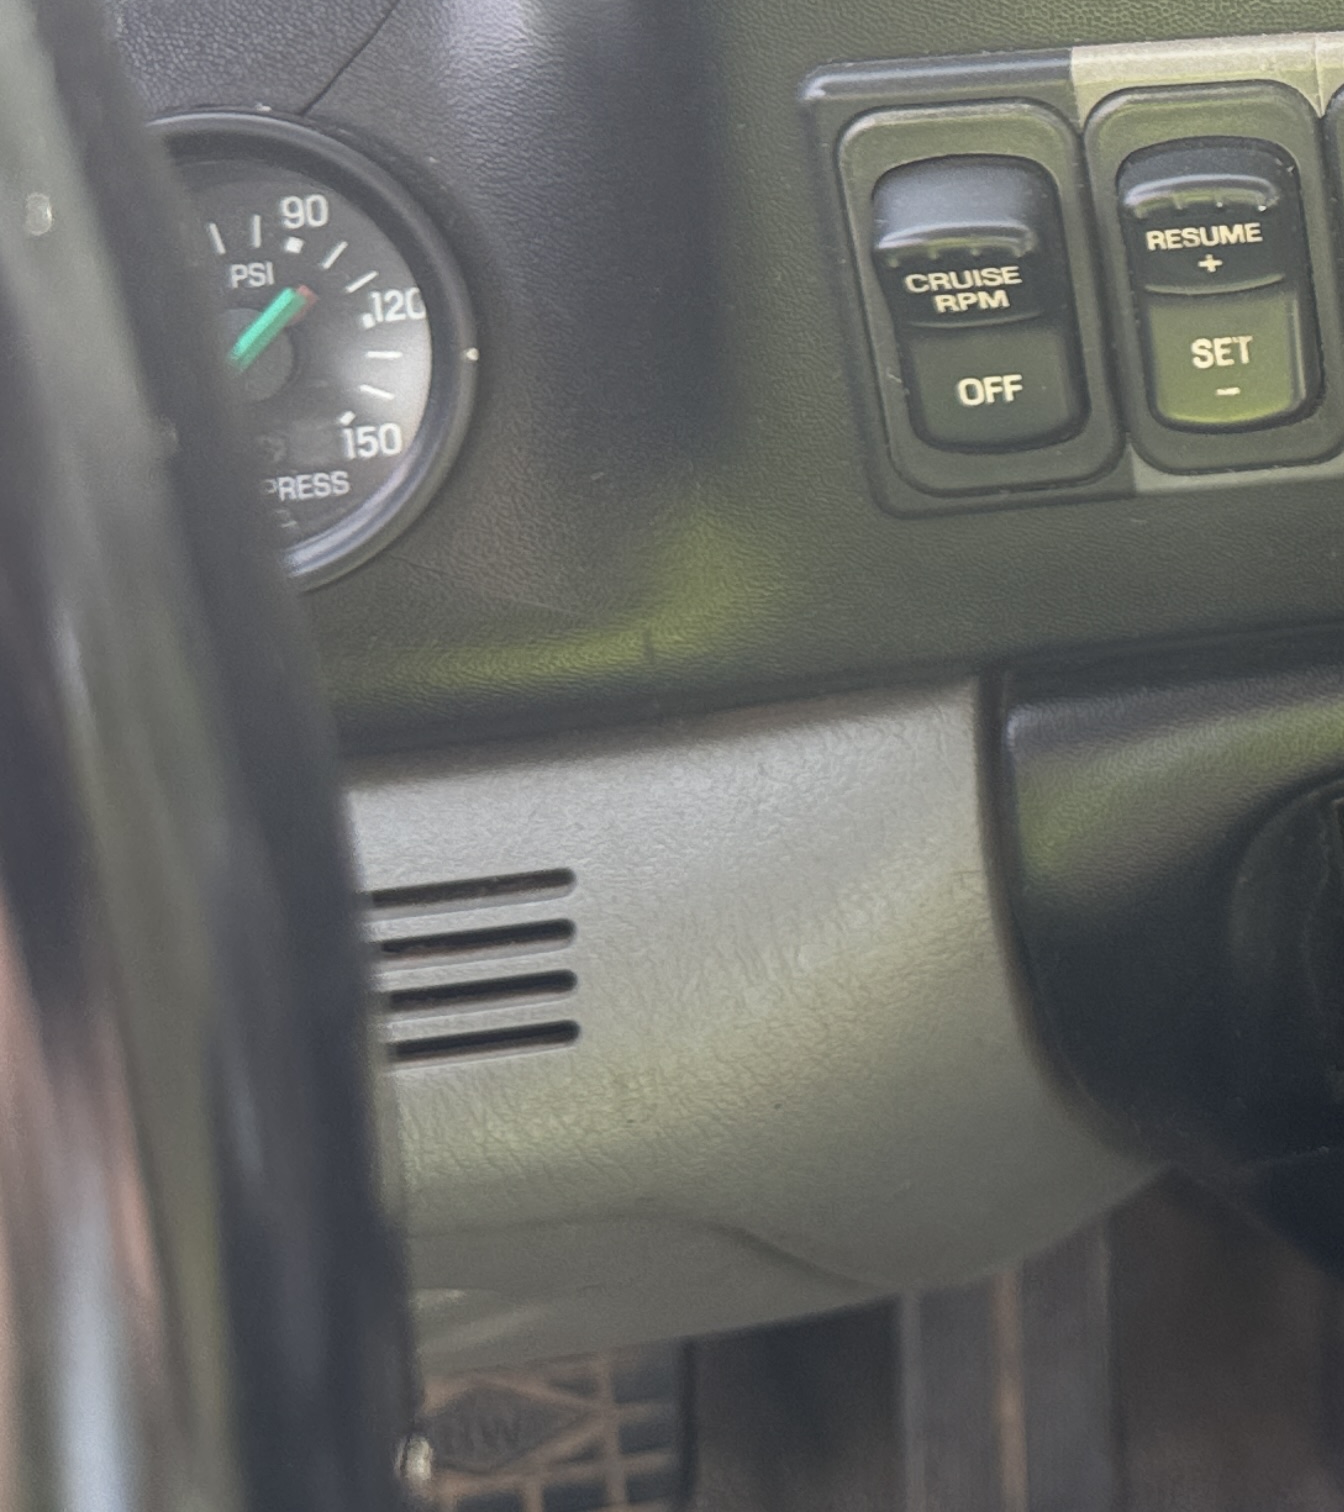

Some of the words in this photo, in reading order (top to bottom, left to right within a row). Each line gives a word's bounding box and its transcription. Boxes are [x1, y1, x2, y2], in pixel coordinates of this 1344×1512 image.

[280, 195, 329, 229] 90
[1146, 222, 1264, 251] RESUME
[230, 262, 275, 289] PSI
[905, 266, 1022, 293] CRUISE
[371, 288, 427, 322] 120
[934, 285, 1011, 314] RPM
[1190, 335, 1253, 369] SET
[956, 374, 1023, 407] OFF
[343, 422, 403, 460] 150
